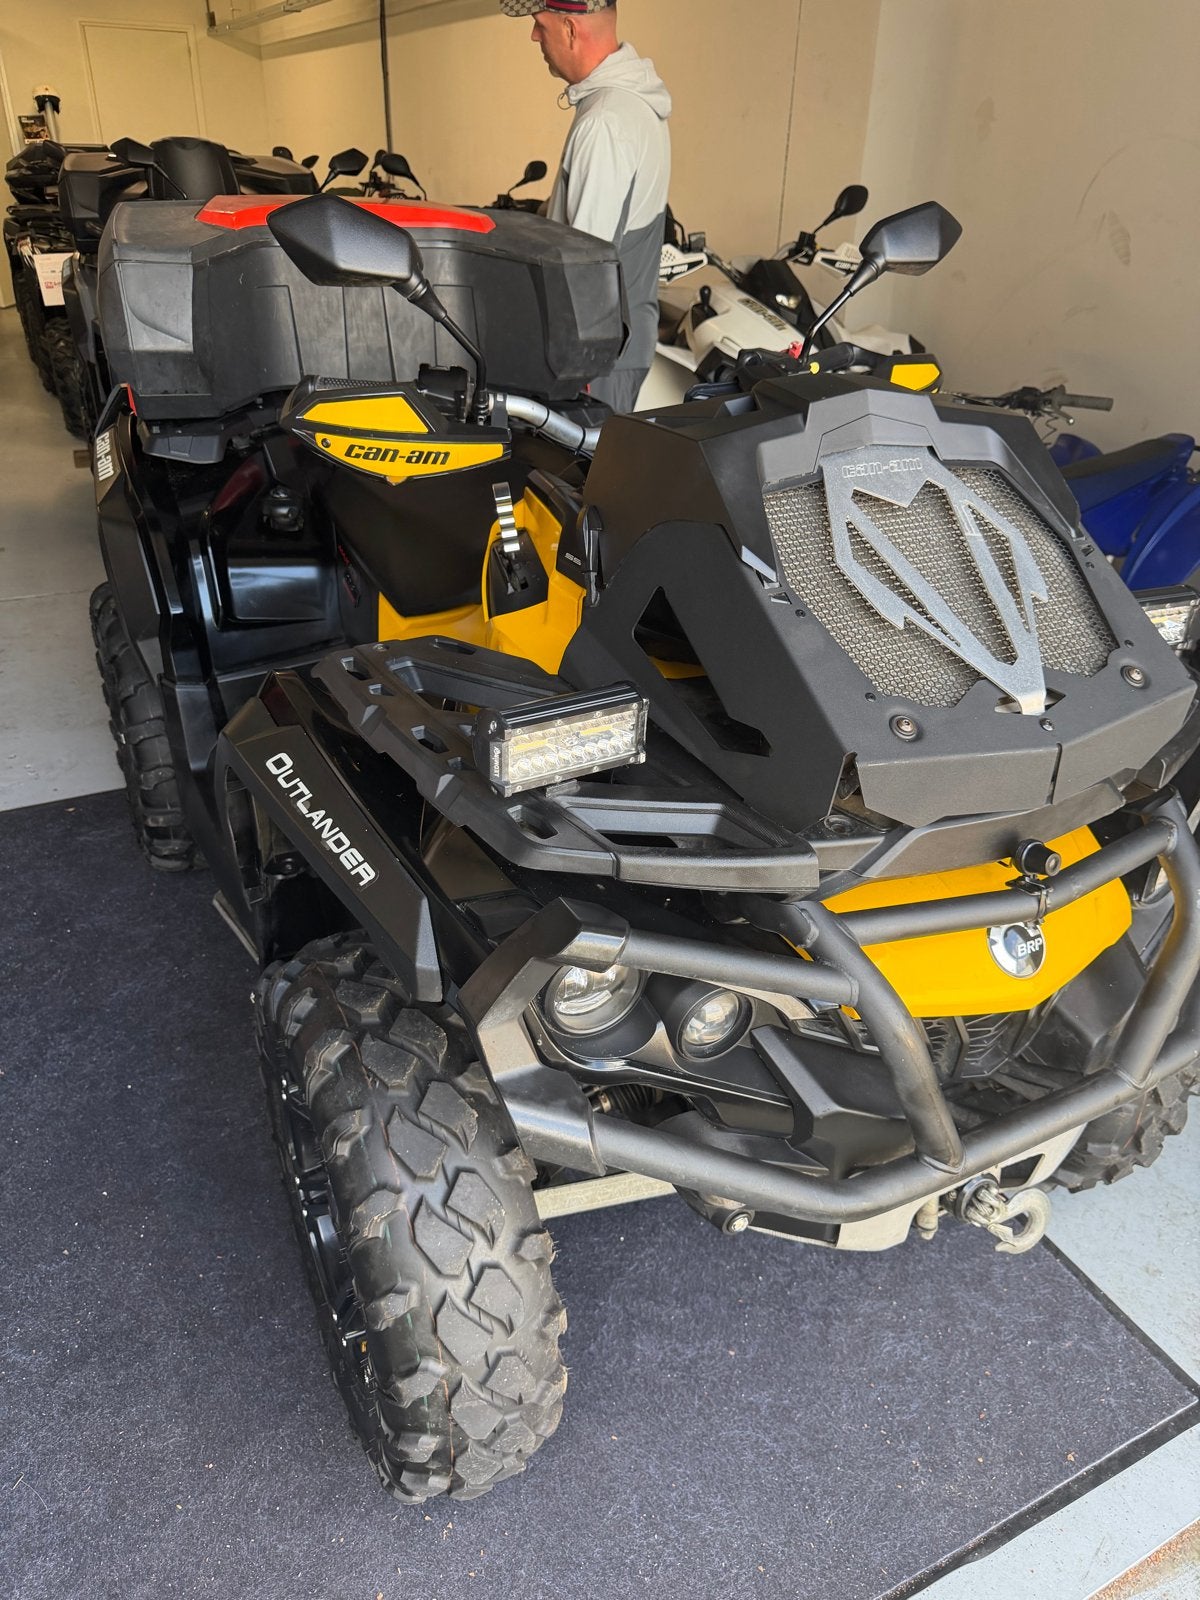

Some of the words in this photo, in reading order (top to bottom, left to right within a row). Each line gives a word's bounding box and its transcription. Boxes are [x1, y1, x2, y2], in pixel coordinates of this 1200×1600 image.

[97, 431, 114, 481] can-am
[344, 444, 451, 465] can-am
[842, 458, 922, 479] can-am
[265, 752, 376, 887] OUTLANDER
[1017, 937, 1043, 957] BRP
